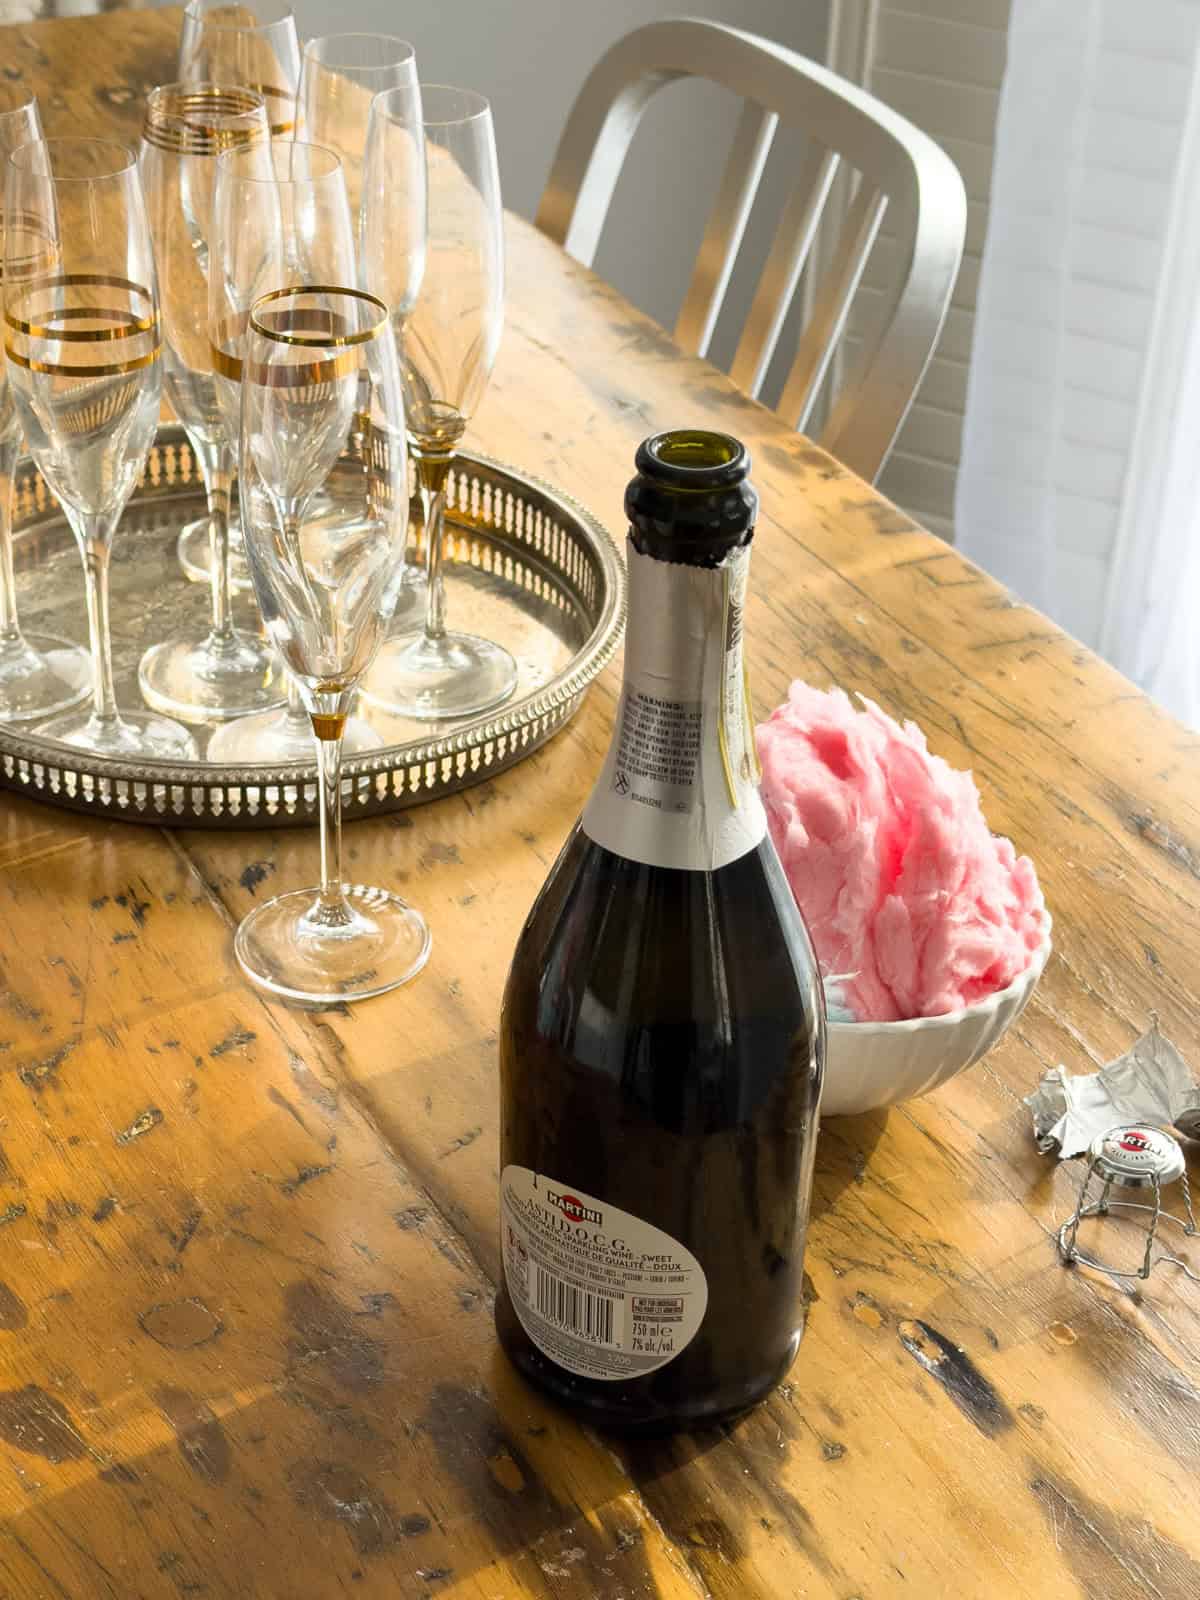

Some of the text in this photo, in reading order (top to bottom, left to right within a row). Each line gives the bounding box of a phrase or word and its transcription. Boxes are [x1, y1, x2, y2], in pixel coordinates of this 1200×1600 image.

[547, 1190, 602, 1224] MARTINI
[562, 1231, 609, 1255] SPARKLING
[610, 1249, 633, 1260] WINE
[641, 1254, 672, 1263] SWEET
[591, 1251, 603, 1261] DE
[653, 1263, 682, 1271] DOUX
[632, 1322, 647, 1337] 750
[632, 1338, 643, 1351] 7%
